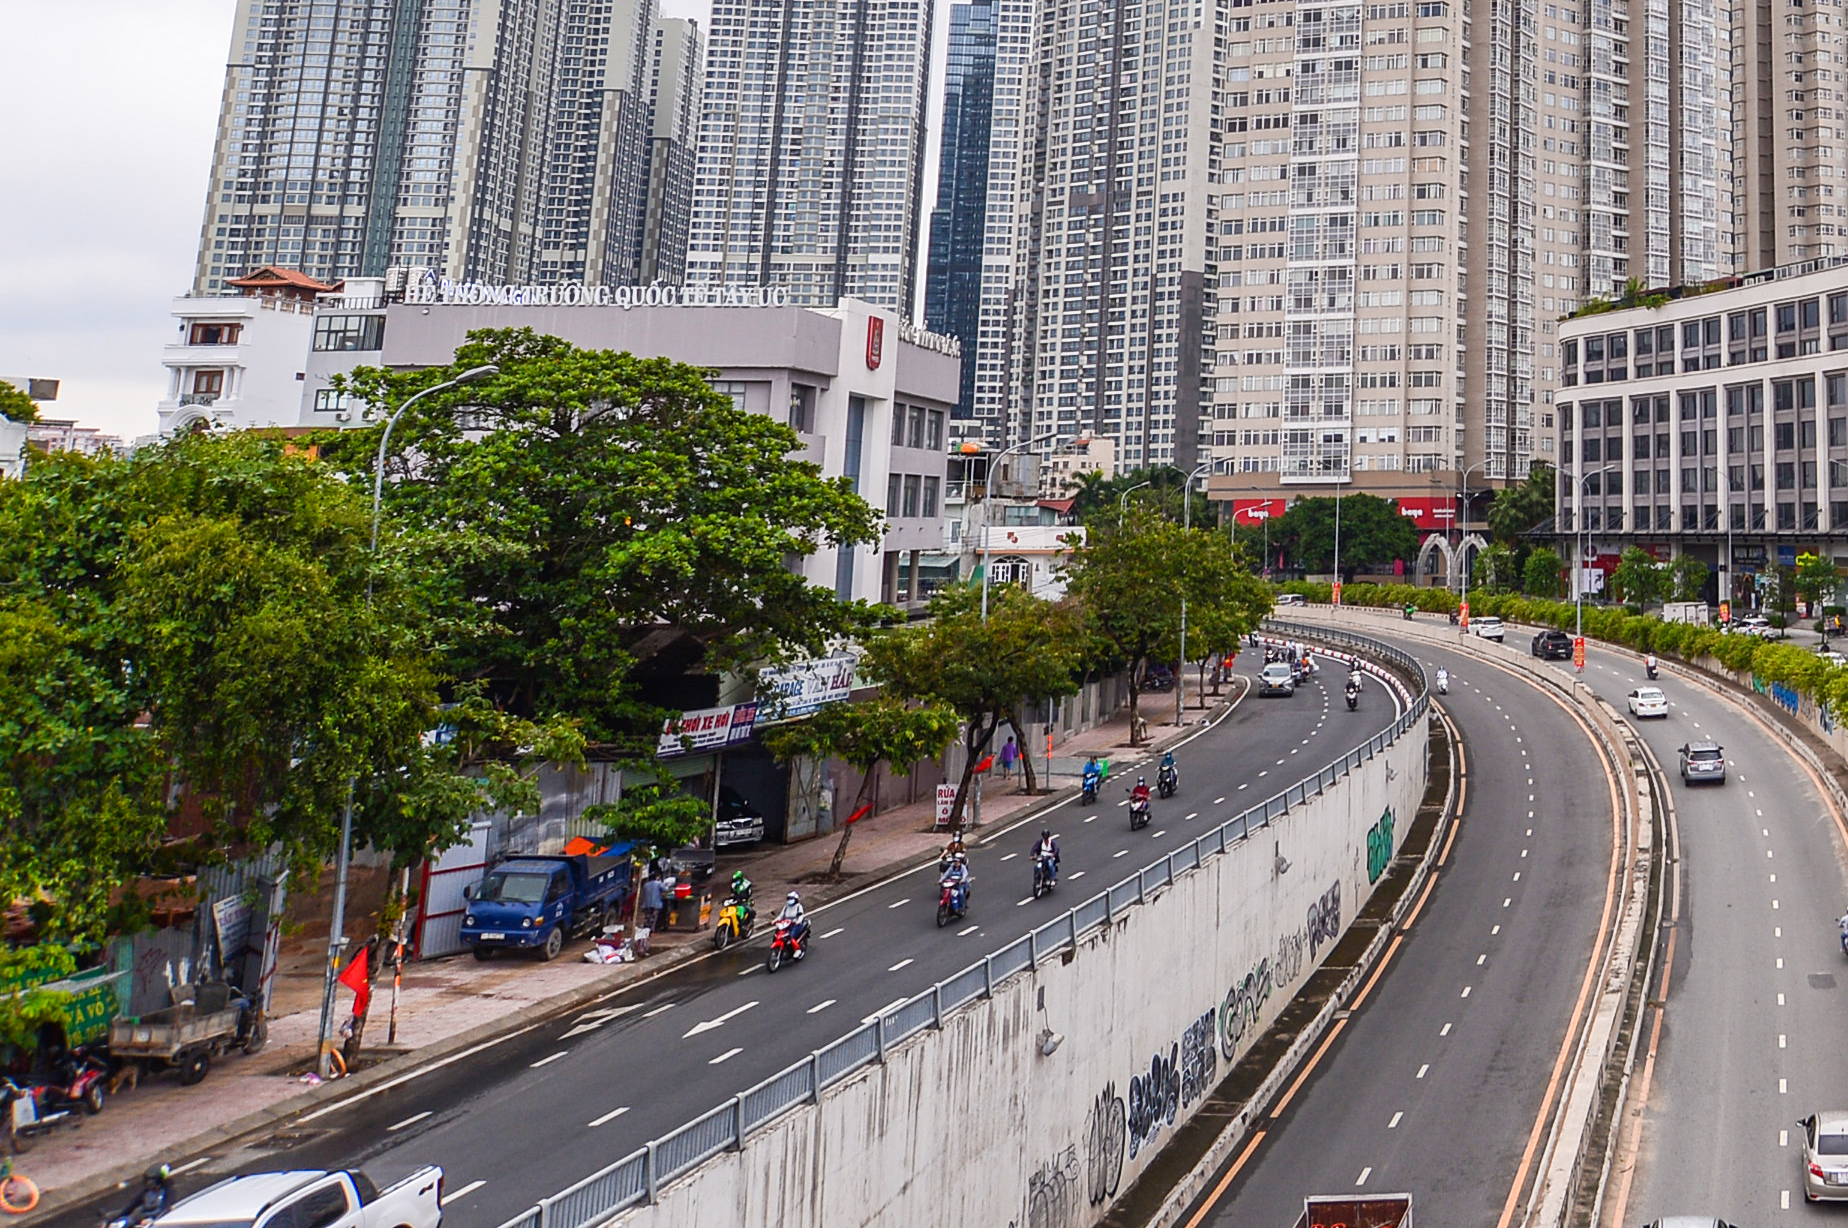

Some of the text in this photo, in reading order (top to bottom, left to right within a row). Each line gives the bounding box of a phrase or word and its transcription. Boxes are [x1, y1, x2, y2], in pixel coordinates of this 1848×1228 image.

[614, 278, 677, 311] QUỐC
[701, 714, 715, 731] XE
[937, 784, 955, 798] RỬA
